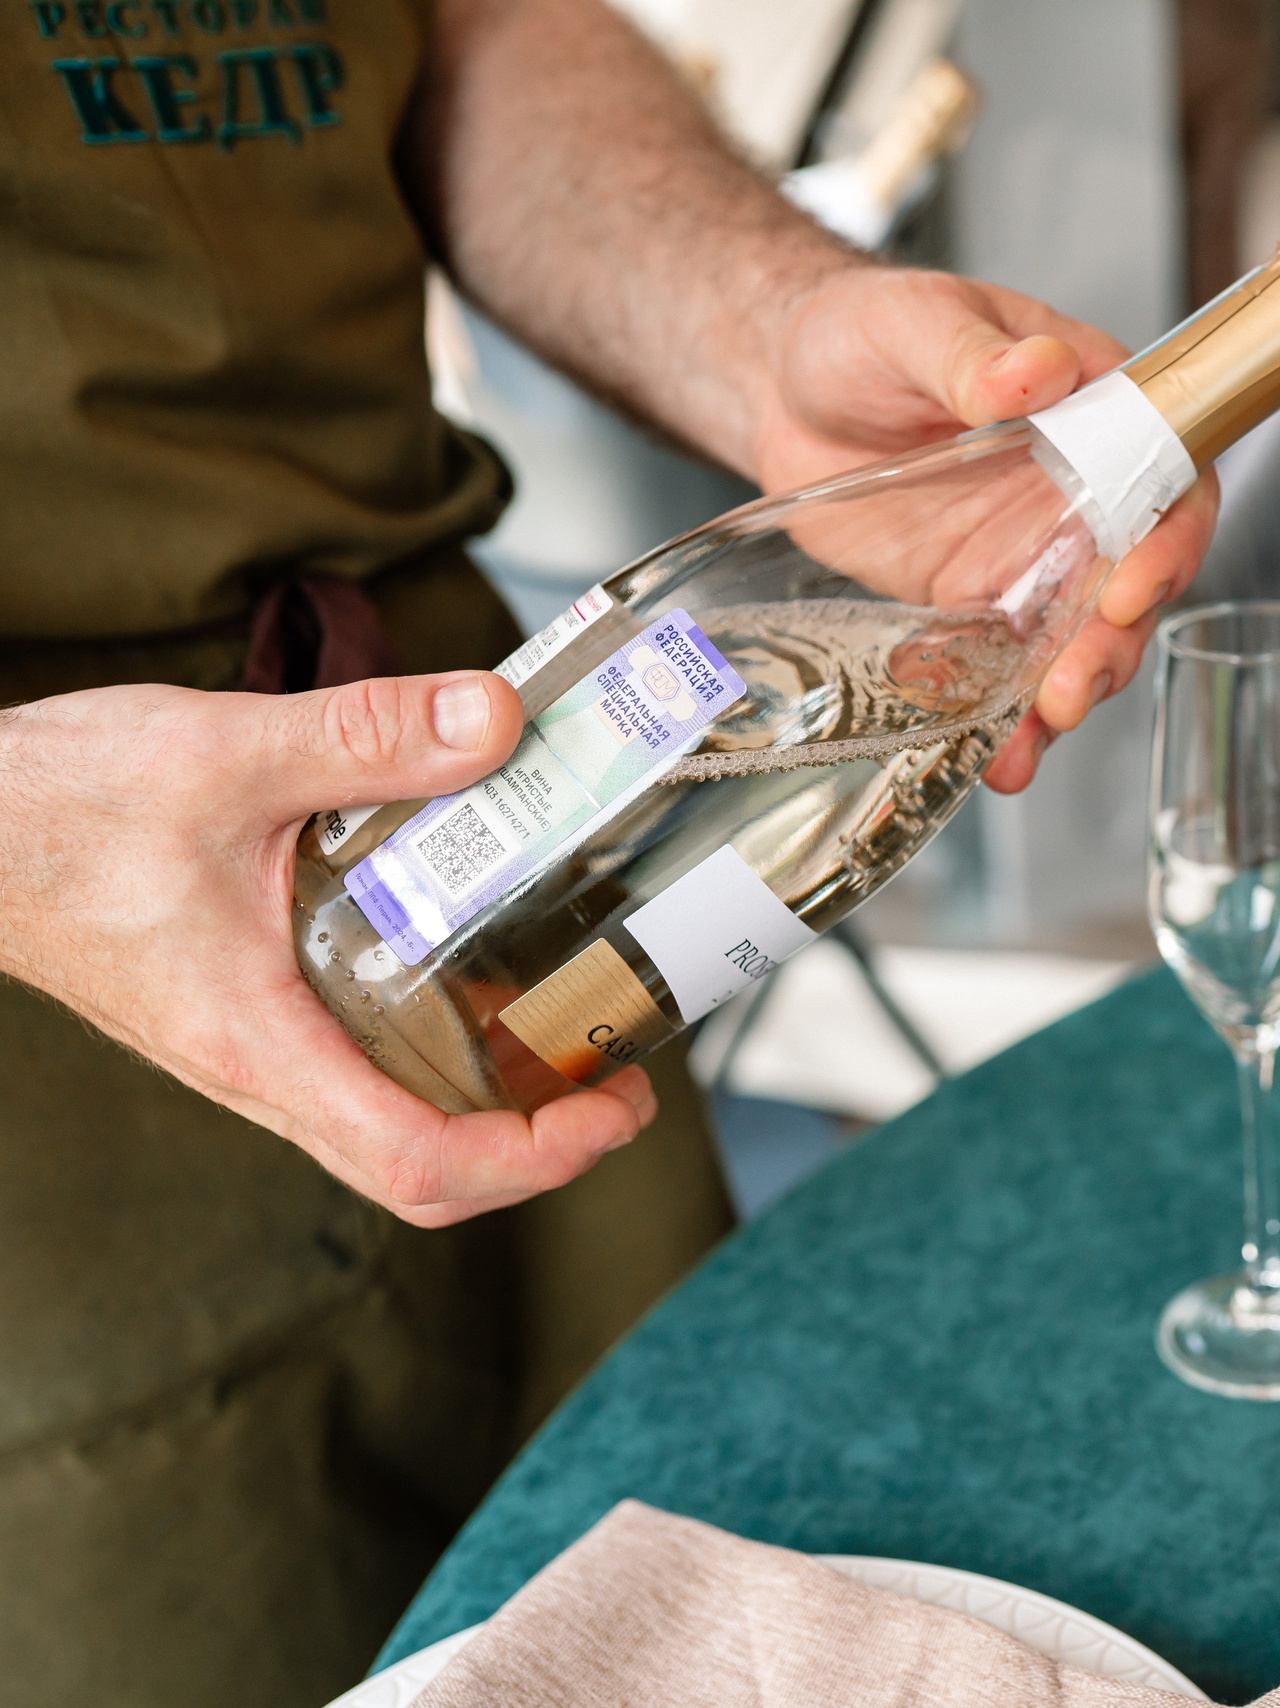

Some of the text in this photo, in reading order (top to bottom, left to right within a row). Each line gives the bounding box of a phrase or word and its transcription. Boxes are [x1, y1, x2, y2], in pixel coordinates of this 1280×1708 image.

[52, 44, 344, 153] КЕДР
[655, 632, 716, 703] ФЕДЕРАЦИЯ
[663, 624, 725, 696] РОССИЙСКАЯ
[597, 673, 660, 749] СПЕЦИАЛЬНАЯ
[600, 698, 634, 738] МАРКА
[607, 666, 671, 742] ФЕДЕРАЛЬНАЯ
[483, 782, 499, 800] 403
[497, 766, 552, 833] (ШАМПАНСКИЕ)
[514, 767, 553, 814] ИГРИСТЫЕ
[530, 769, 553, 796] ВИНА
[324, 809, 347, 840] mple
